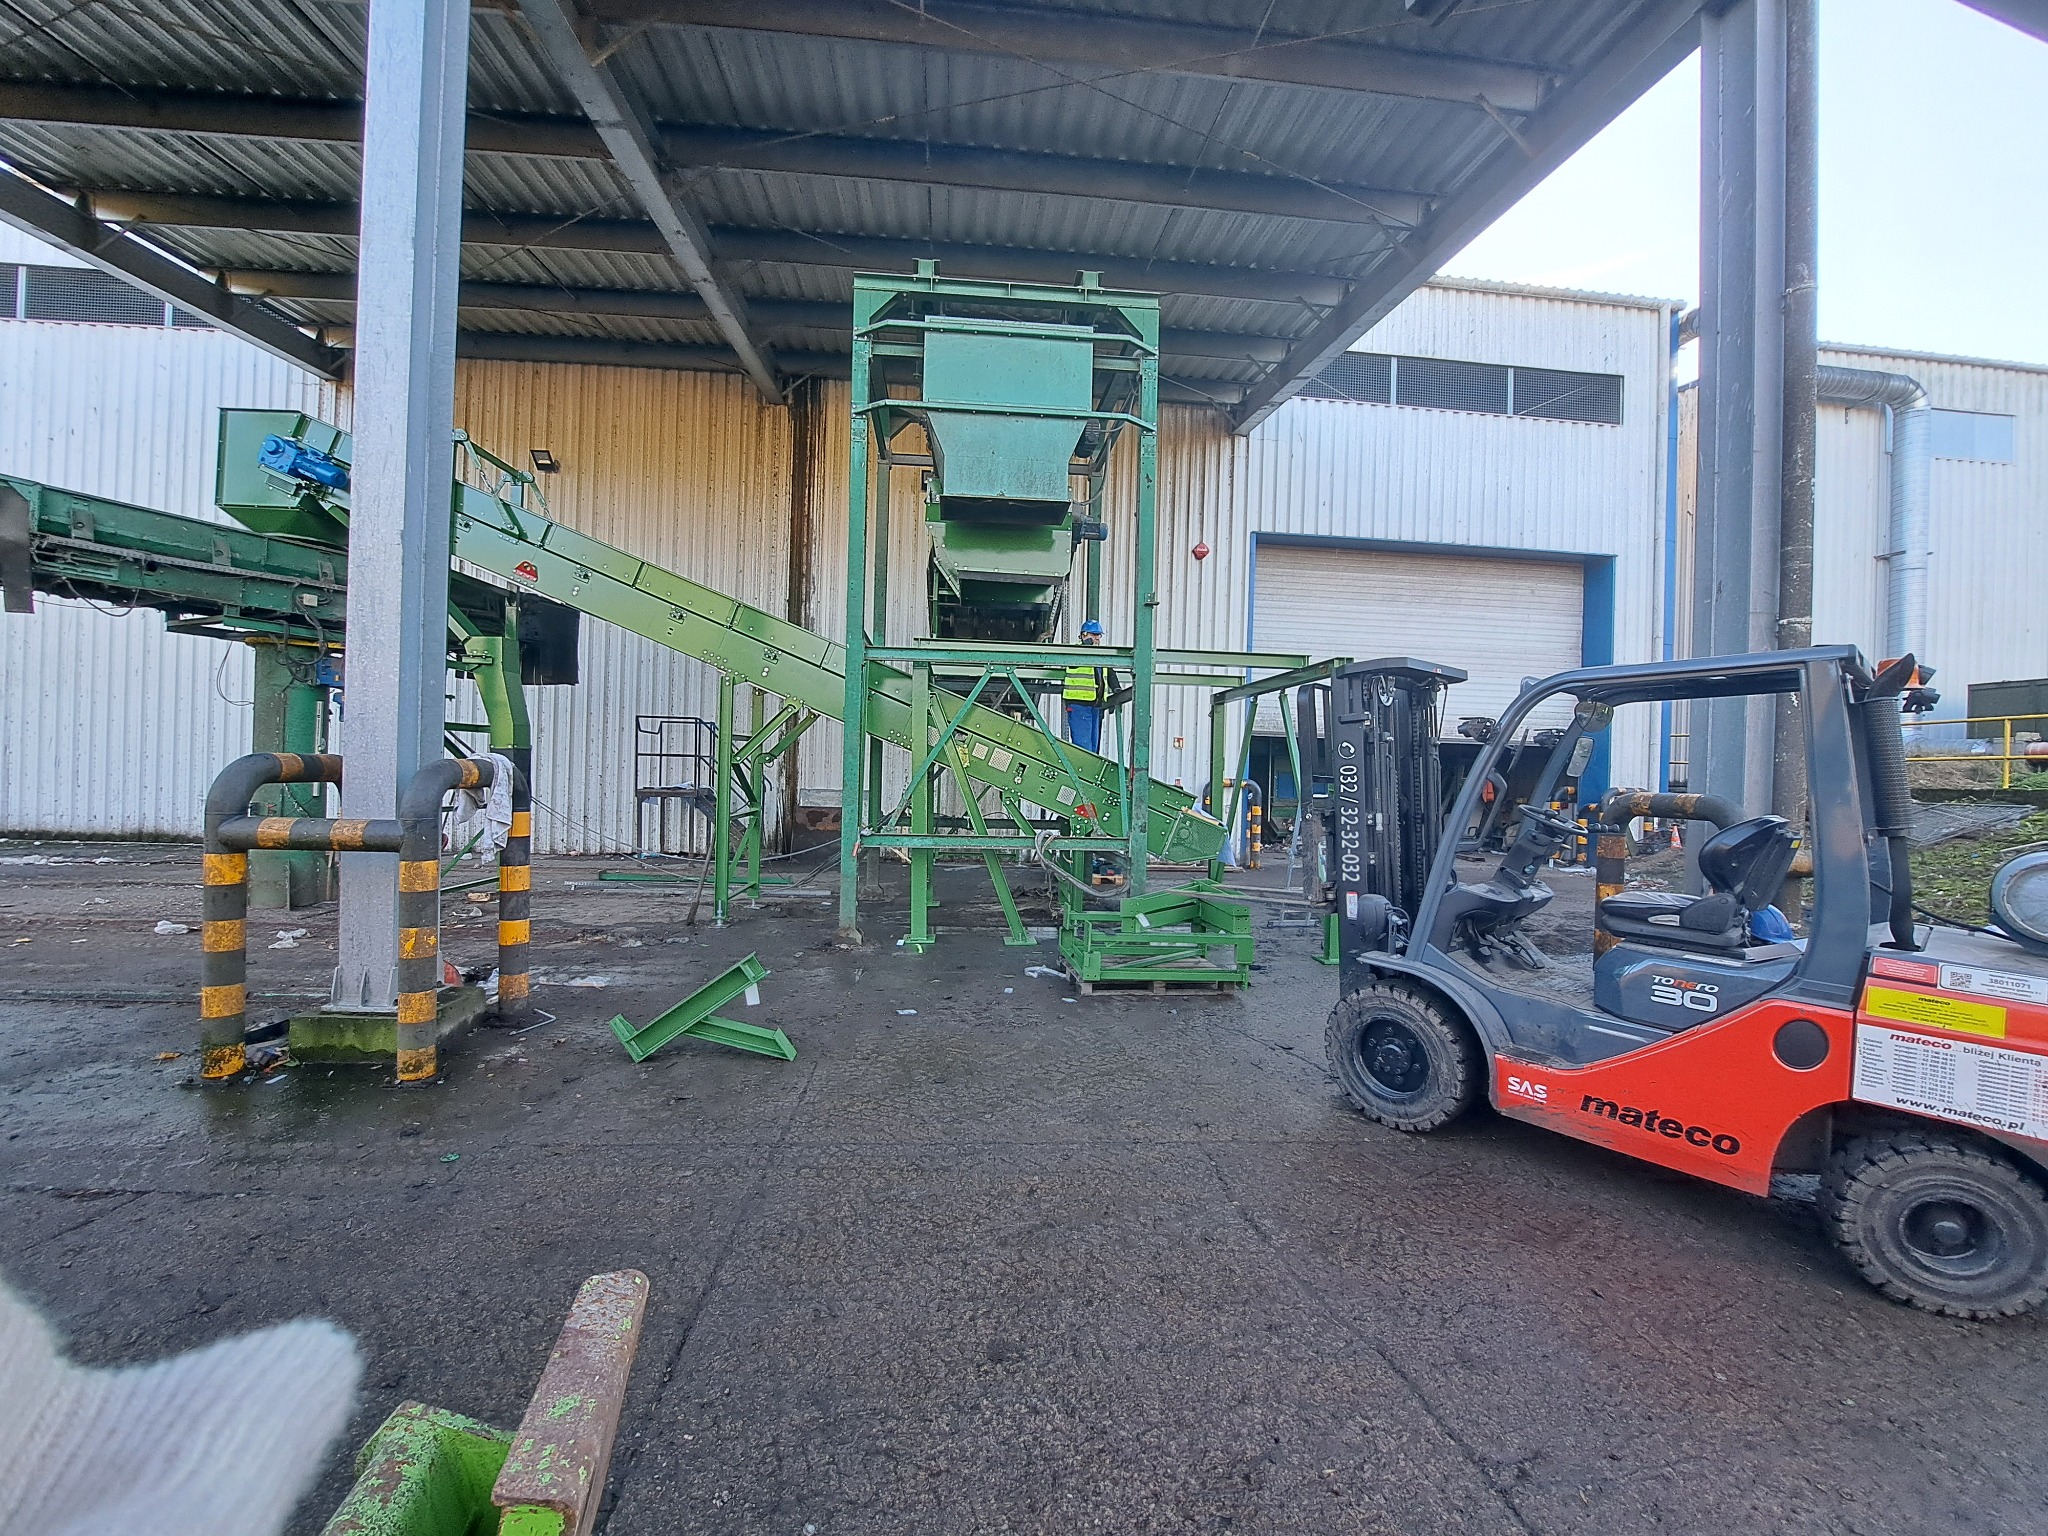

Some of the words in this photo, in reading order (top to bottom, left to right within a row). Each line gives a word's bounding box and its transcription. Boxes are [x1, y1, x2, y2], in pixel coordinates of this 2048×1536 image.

[1340, 765, 1358, 792] 032
[1340, 806, 1360, 882] 32-32-032
[1988, 978, 2031, 990] 38011071
[1650, 985, 1718, 1012] 30
[1918, 997, 1950, 1006] mateco
[1890, 1034, 1952, 1050] mateco
[1998, 1053, 2041, 1066] Klienta
[1508, 1076, 1547, 1099] SAS
[1580, 1094, 1741, 1155] mateco
[1896, 1097, 2025, 1130] www.mateco.pl
